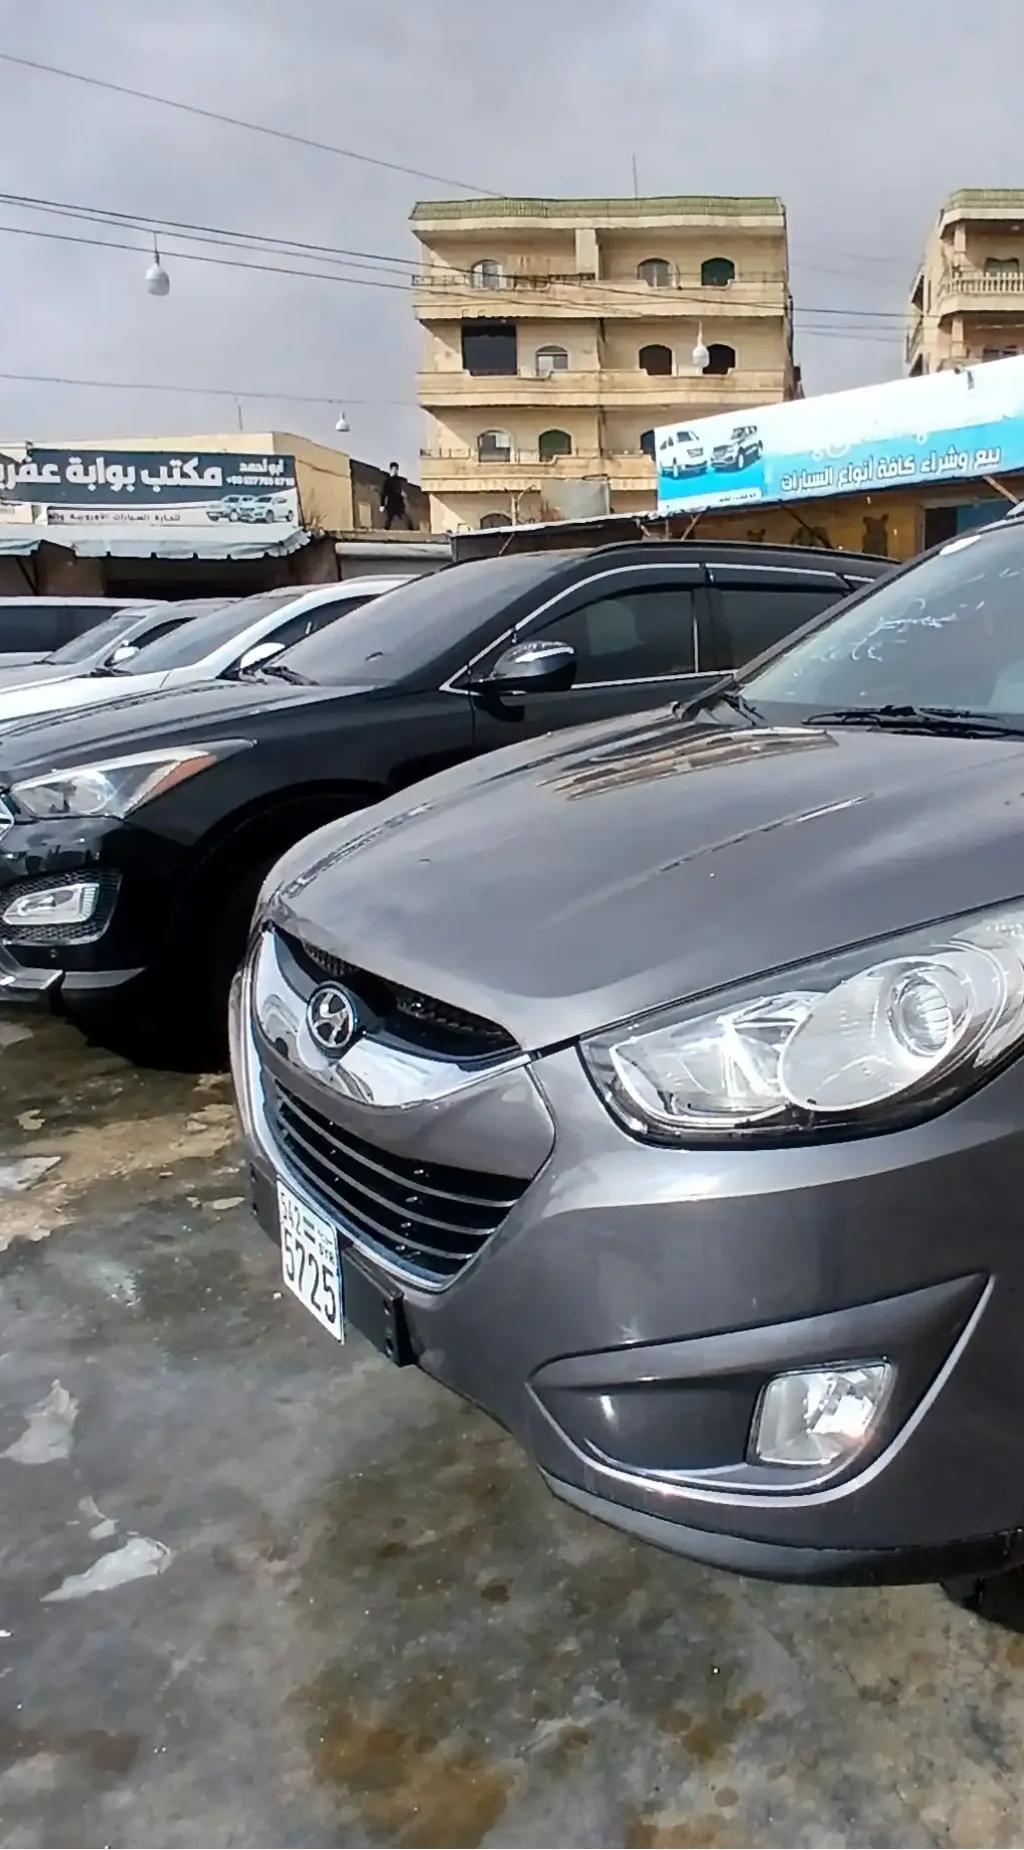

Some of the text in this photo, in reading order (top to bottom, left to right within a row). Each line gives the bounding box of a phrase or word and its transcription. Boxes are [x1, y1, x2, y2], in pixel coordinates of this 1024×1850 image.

[876, 454, 916, 481] كافة
[920, 445, 969, 474] وشراء
[974, 447, 1002, 468] بيع
[65, 457, 136, 492] بوابة
[141, 457, 223, 493] مكتب
[781, 467, 833, 494] السيارات
[284, 1227, 337, 1325] 5725
